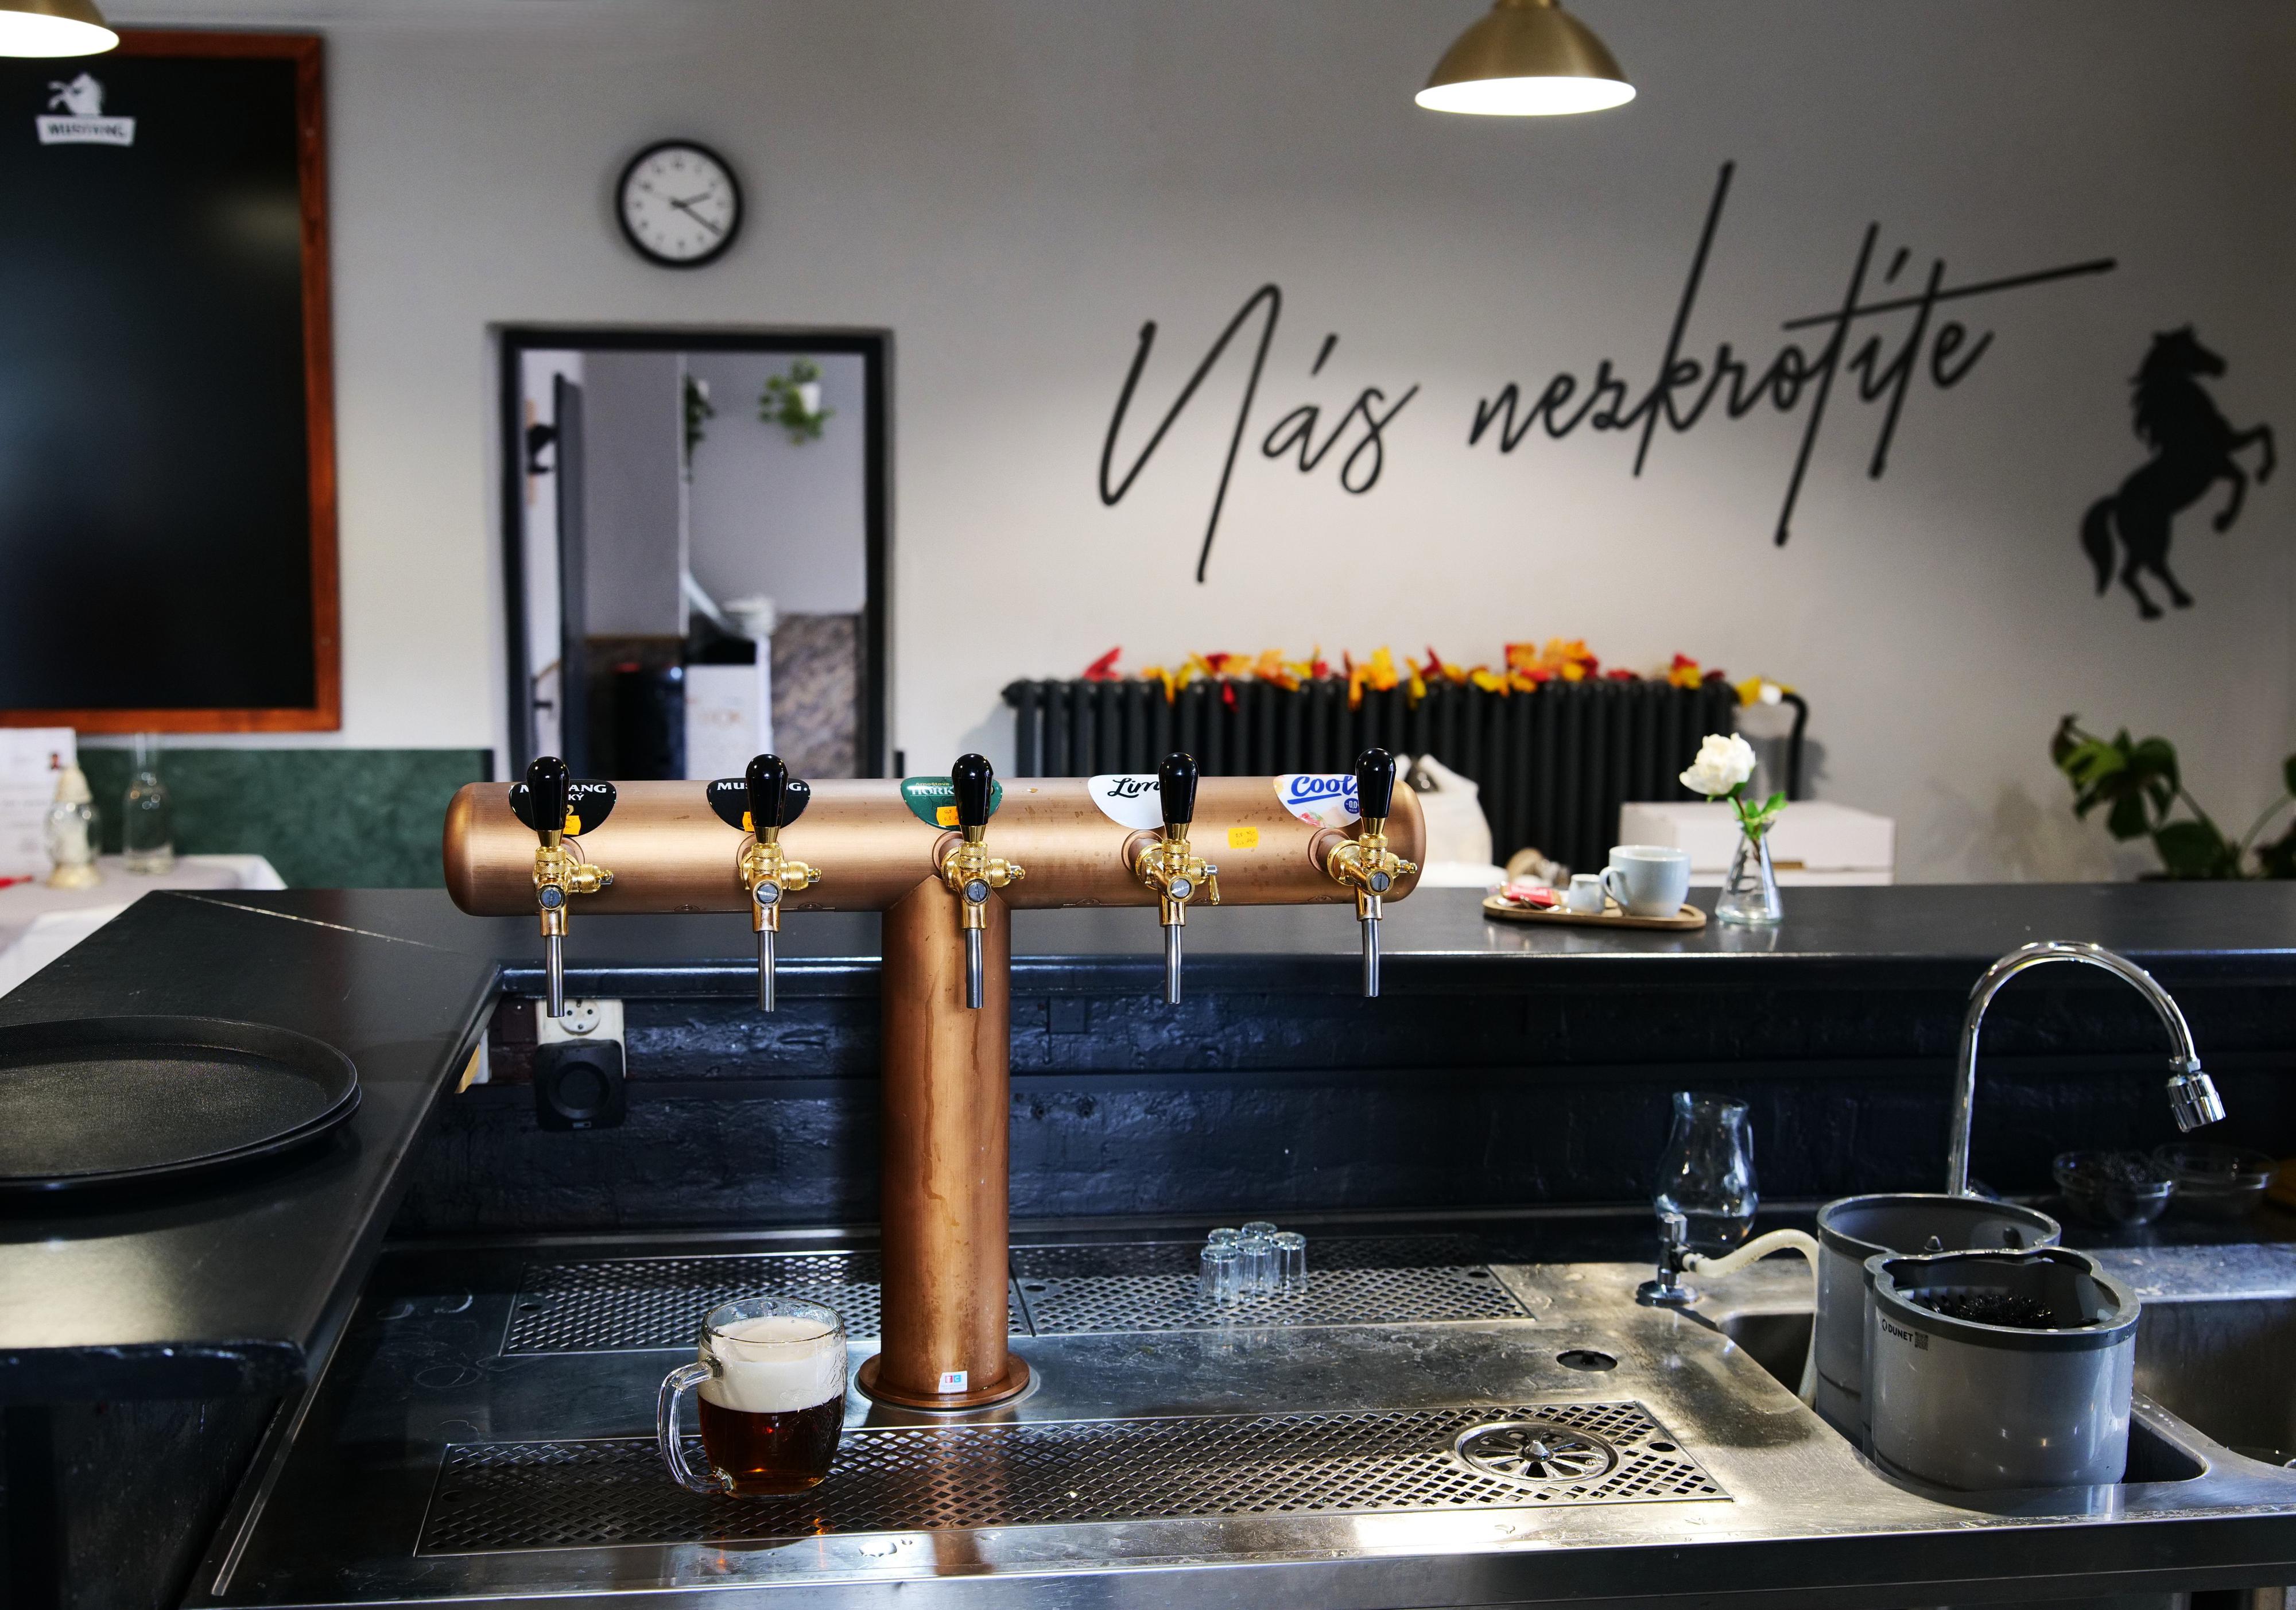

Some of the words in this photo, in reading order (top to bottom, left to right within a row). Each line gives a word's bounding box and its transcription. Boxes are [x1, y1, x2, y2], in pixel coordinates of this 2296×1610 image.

[1099, 284, 1419, 584] Nás
[1468, 162, 2115, 548] nezkrotíte
[519, 784, 607, 793] MANG
[911, 785, 955, 795] HOŘK
[1107, 778, 1159, 798] Lim
[1888, 1325, 1914, 1342] DUNET
